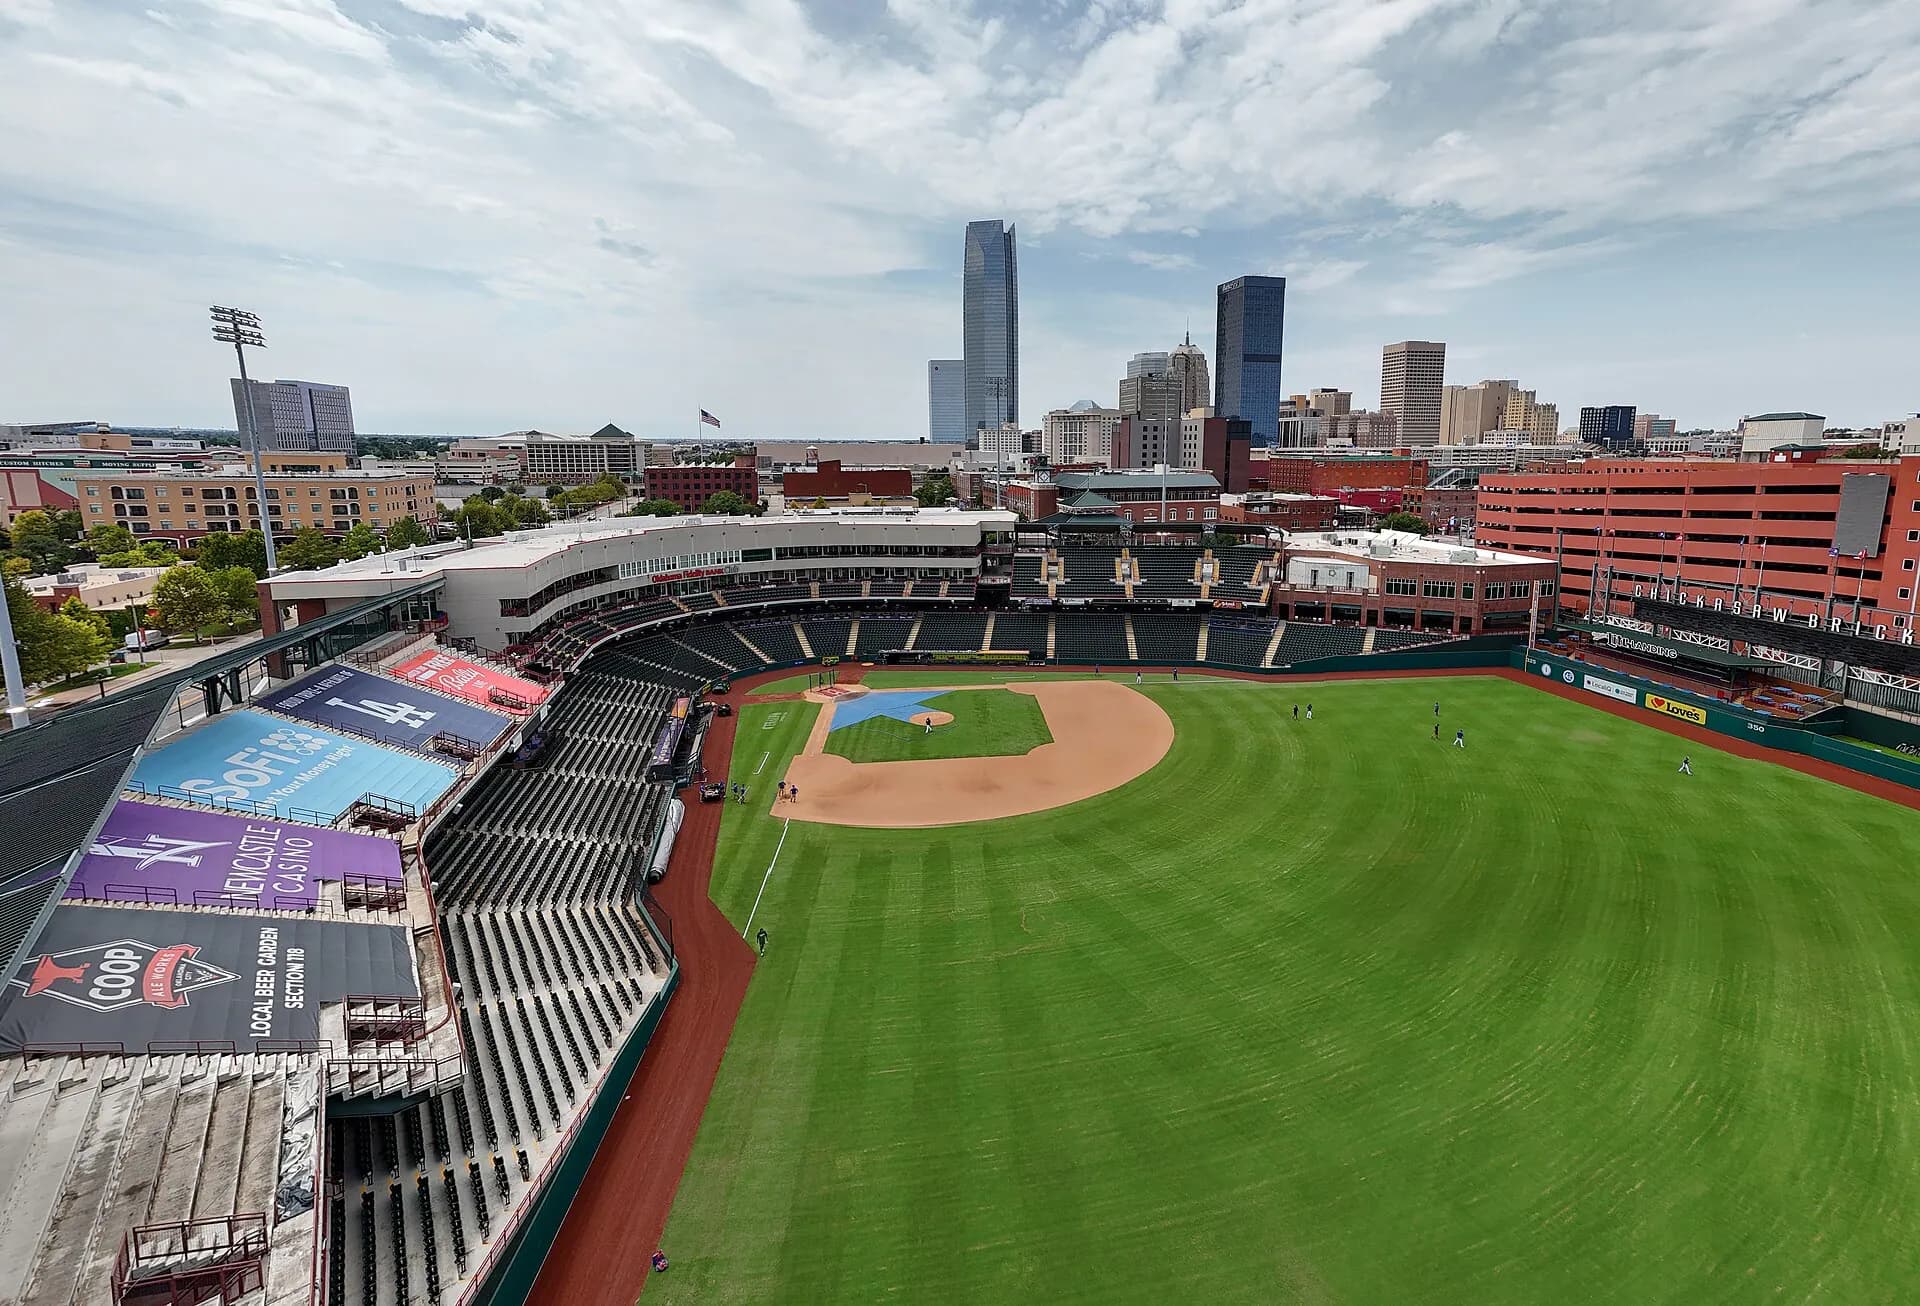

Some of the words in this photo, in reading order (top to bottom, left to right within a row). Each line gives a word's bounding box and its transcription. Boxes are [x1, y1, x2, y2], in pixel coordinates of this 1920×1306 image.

[652, 572, 682, 583] Oklahoma
[683, 569, 705, 579] Fidelity
[1635, 584, 1789, 622] CHICKASAW
[1631, 640, 1678, 659] LANDING
[324, 696, 437, 729] LA
[1747, 723, 1765, 733] 350
[270, 779, 302, 797] Your
[294, 757, 338, 783] Money
[220, 824, 281, 902] NEWCASTLE
[272, 837, 314, 893] CASINO
[258, 927, 279, 965] GARDEN
[287, 948, 305, 962] 118
[89, 948, 143, 1001] COOP
[154, 952, 176, 978] WORKS
[254, 965, 276, 992] BEER
[151, 978, 164, 997] ALE
[285, 963, 304, 1009] SECTION
[249, 992, 273, 1038] LOCAL
